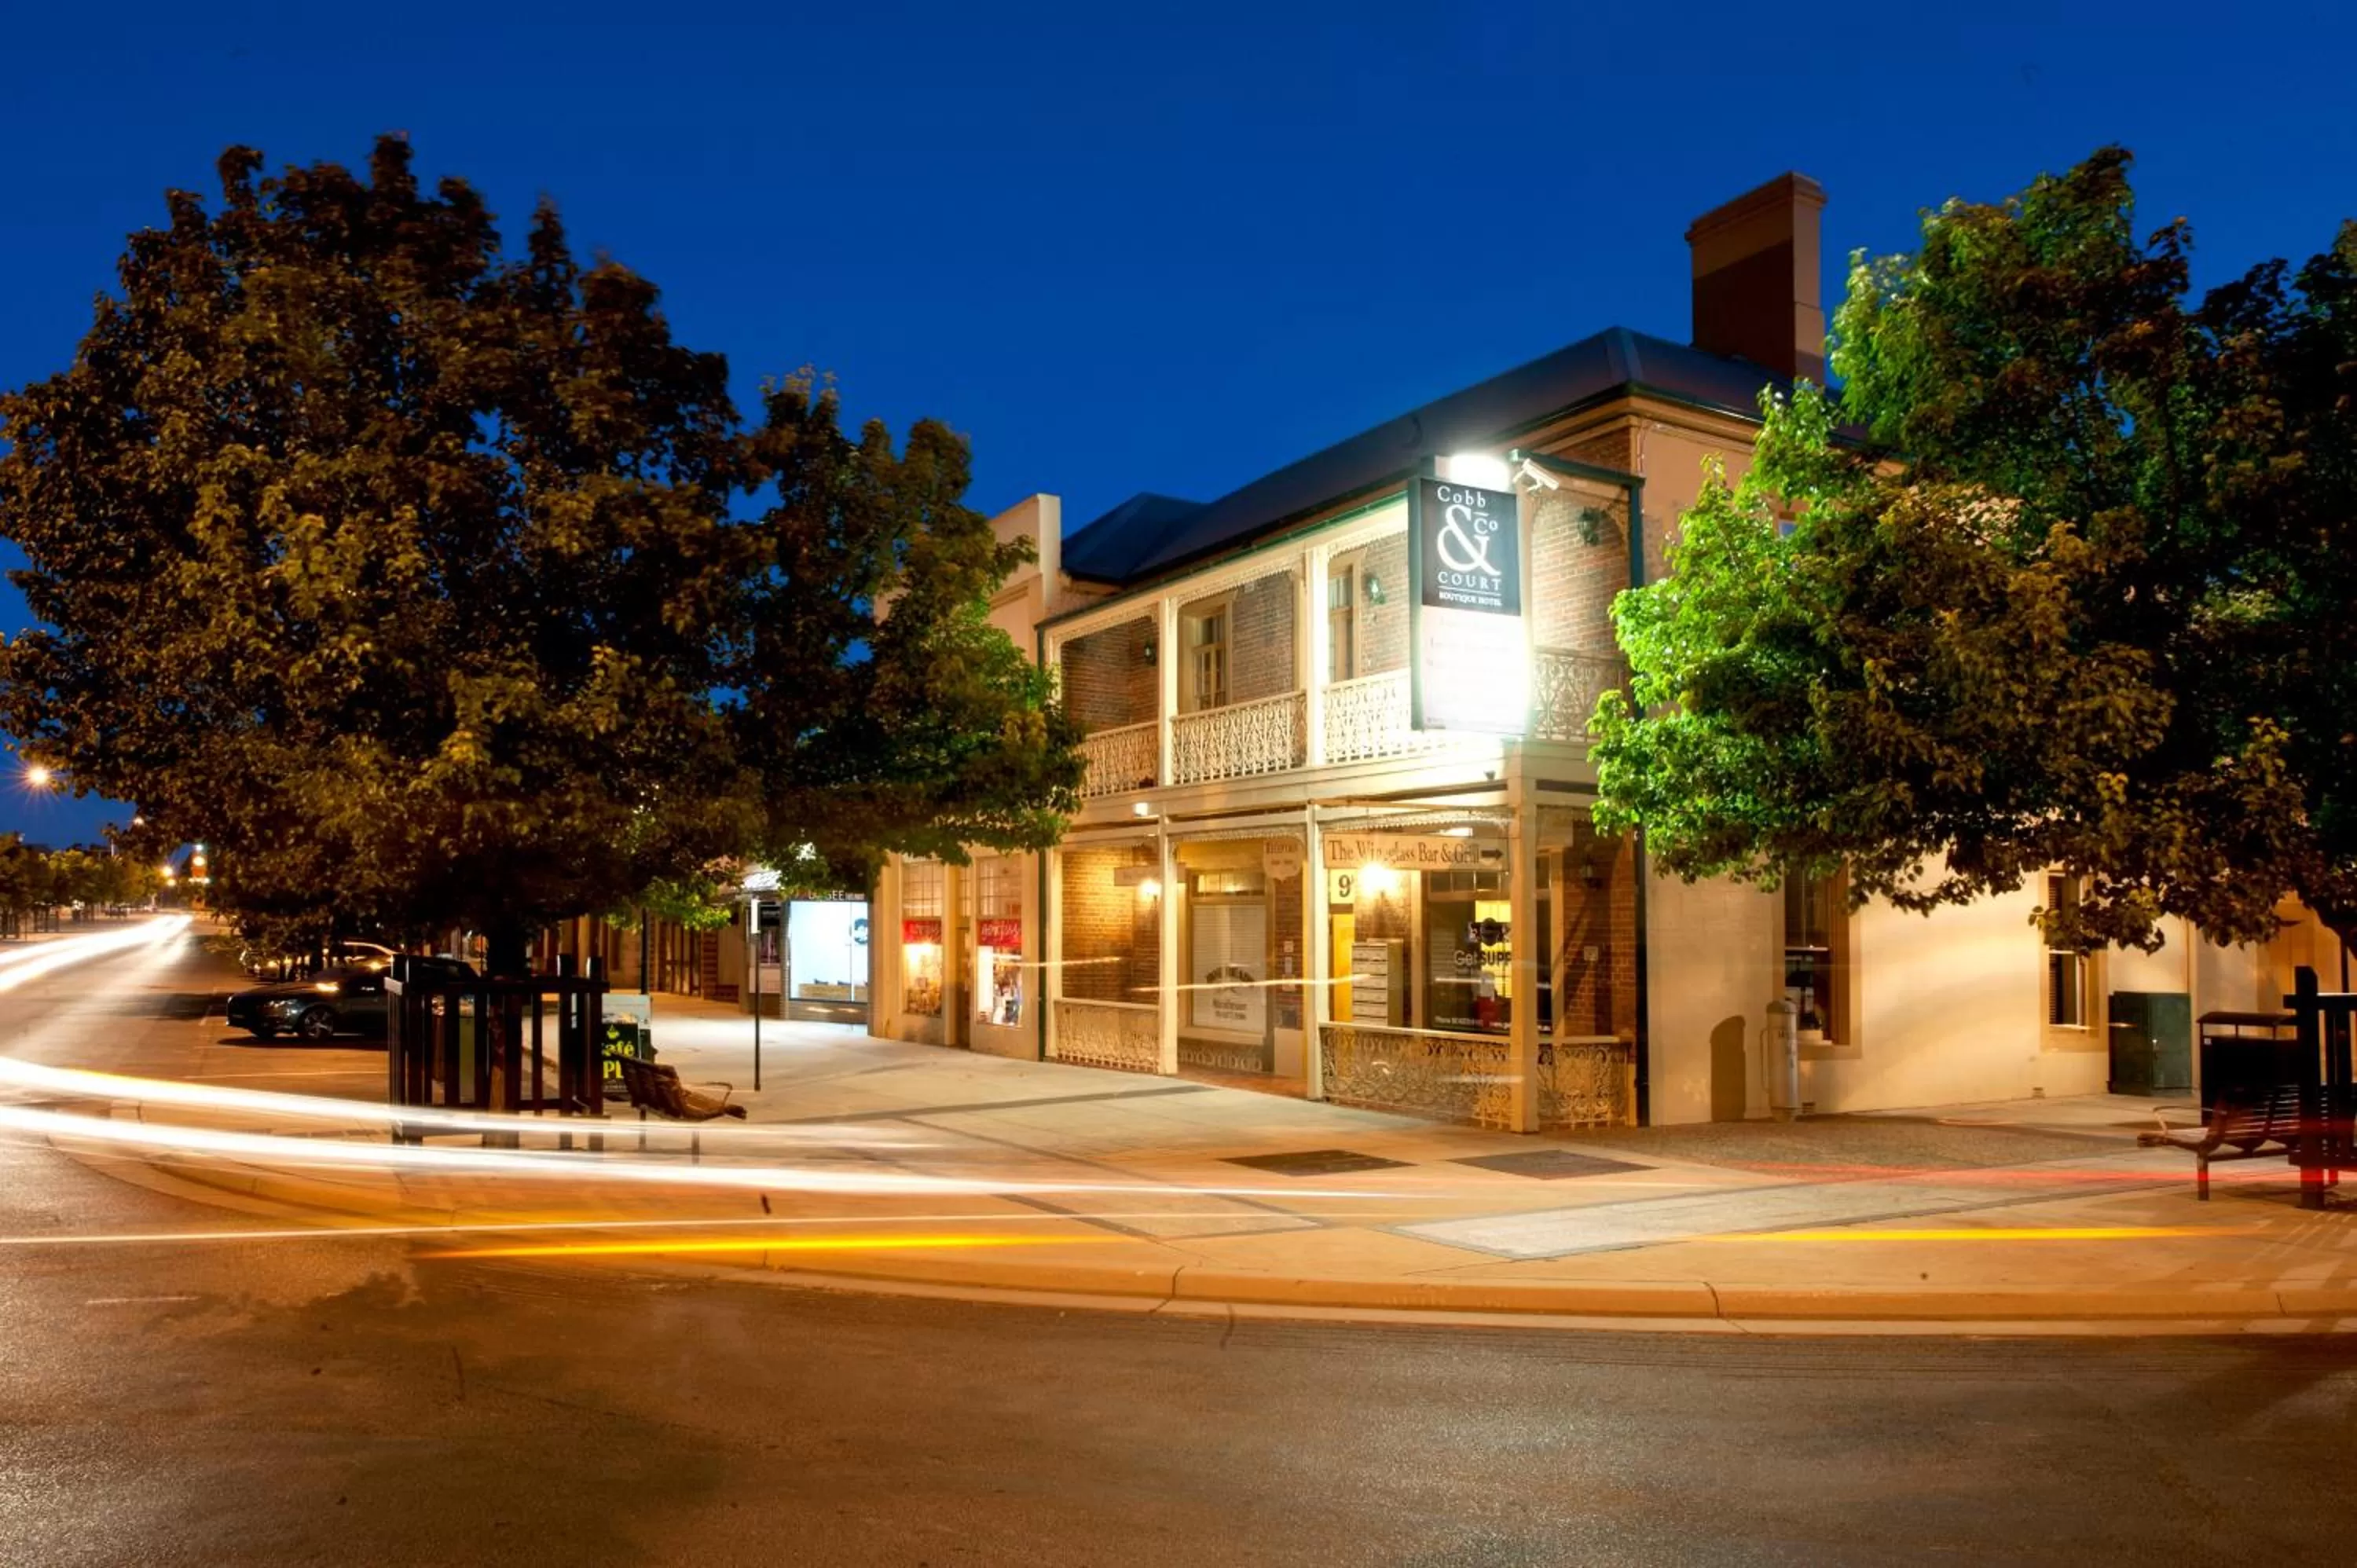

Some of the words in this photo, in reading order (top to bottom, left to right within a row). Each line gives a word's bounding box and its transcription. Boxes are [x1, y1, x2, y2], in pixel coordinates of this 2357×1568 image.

[1437, 485, 1486, 508] Cobb
[1437, 504, 1501, 576] &
[1474, 517, 1499, 535] Co
[1438, 571, 1502, 591] COURT
[1329, 840, 1354, 861] The
[1355, 840, 1415, 864] Winlass
[1417, 841, 1439, 863] Bar
[1440, 843, 1453, 863] &
